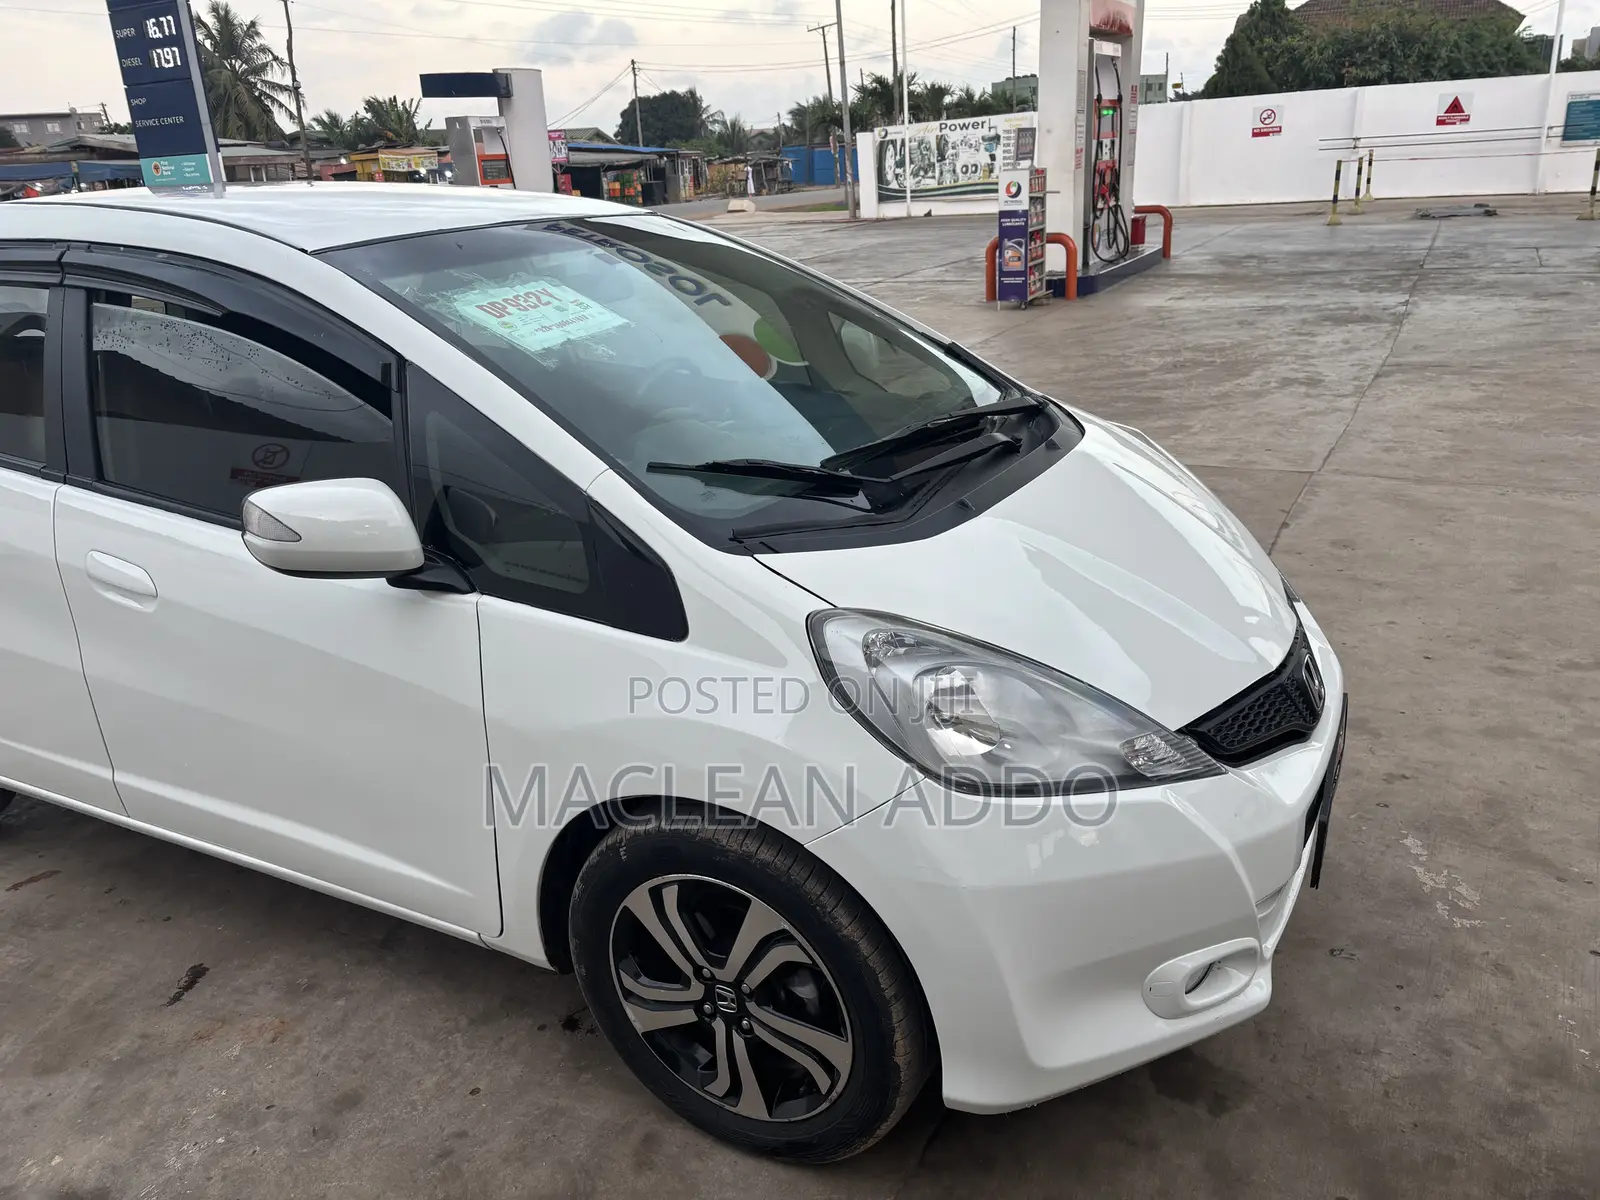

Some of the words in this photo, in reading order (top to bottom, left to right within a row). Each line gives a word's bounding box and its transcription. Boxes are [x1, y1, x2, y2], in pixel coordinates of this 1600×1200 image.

[115, 27, 136, 39] SUPER
[121, 57, 143, 68] DIESEL
[130, 97, 147, 106] SHOP
[135, 118, 160, 128] SERVICE
[159, 115, 185, 125] CENTER
[939, 120, 987, 133] Power
